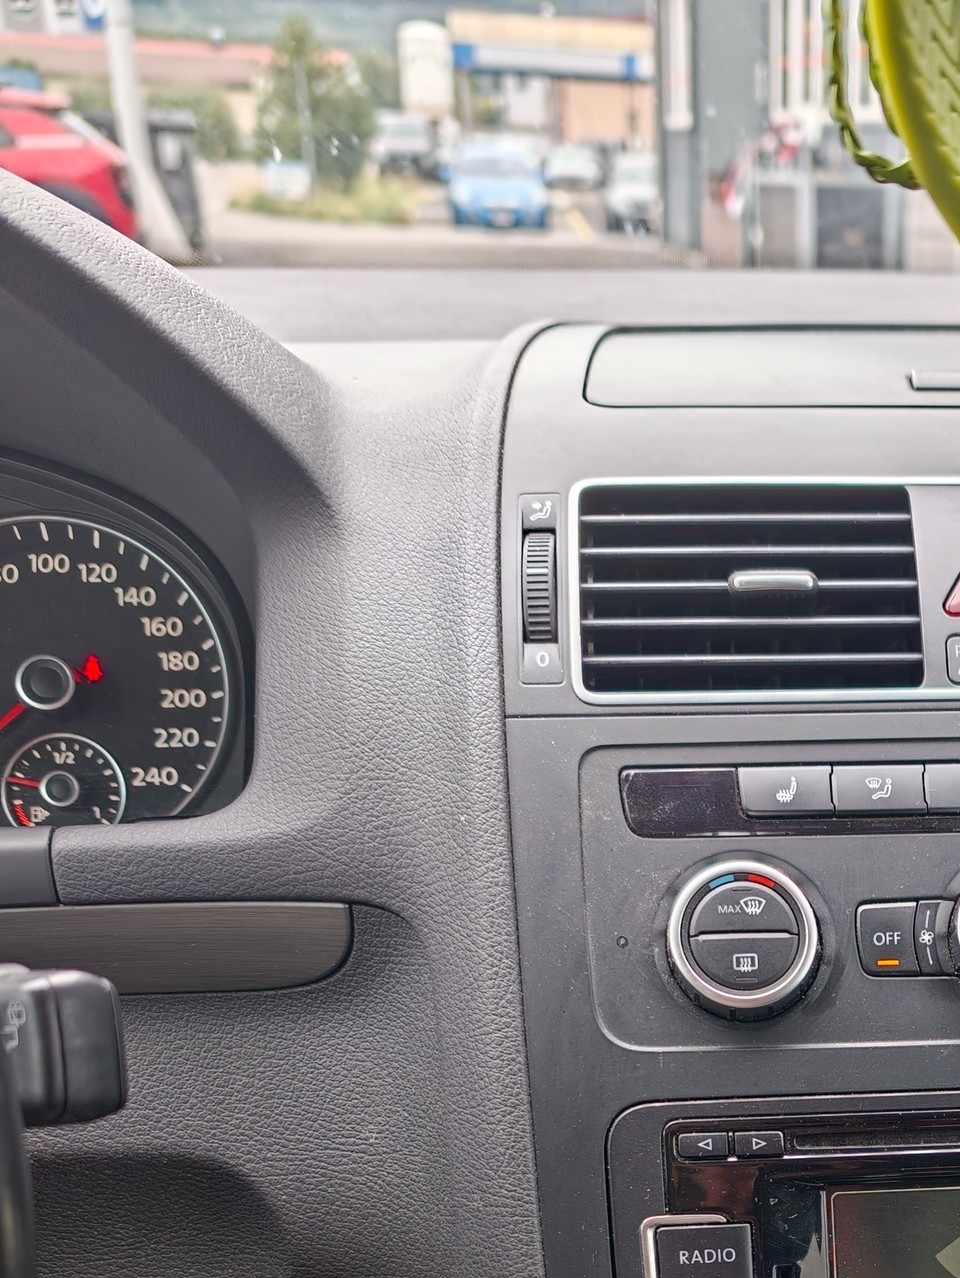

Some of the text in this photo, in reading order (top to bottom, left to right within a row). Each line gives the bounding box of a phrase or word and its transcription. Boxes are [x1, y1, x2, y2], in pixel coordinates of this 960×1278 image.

[27, 553, 70, 573] 100
[77, 563, 117, 583] 120
[0, 564, 19, 584] 0
[114, 586, 156, 607] 140
[140, 617, 183, 637] 160
[158, 651, 200, 671] 180
[160, 688, 206, 708] 200
[154, 728, 199, 748] 220
[131, 766, 178, 787] 240
[717, 904, 741, 914] MAX
[873, 932, 901, 946] OFF
[679, 1248, 736, 1265] RADIO
